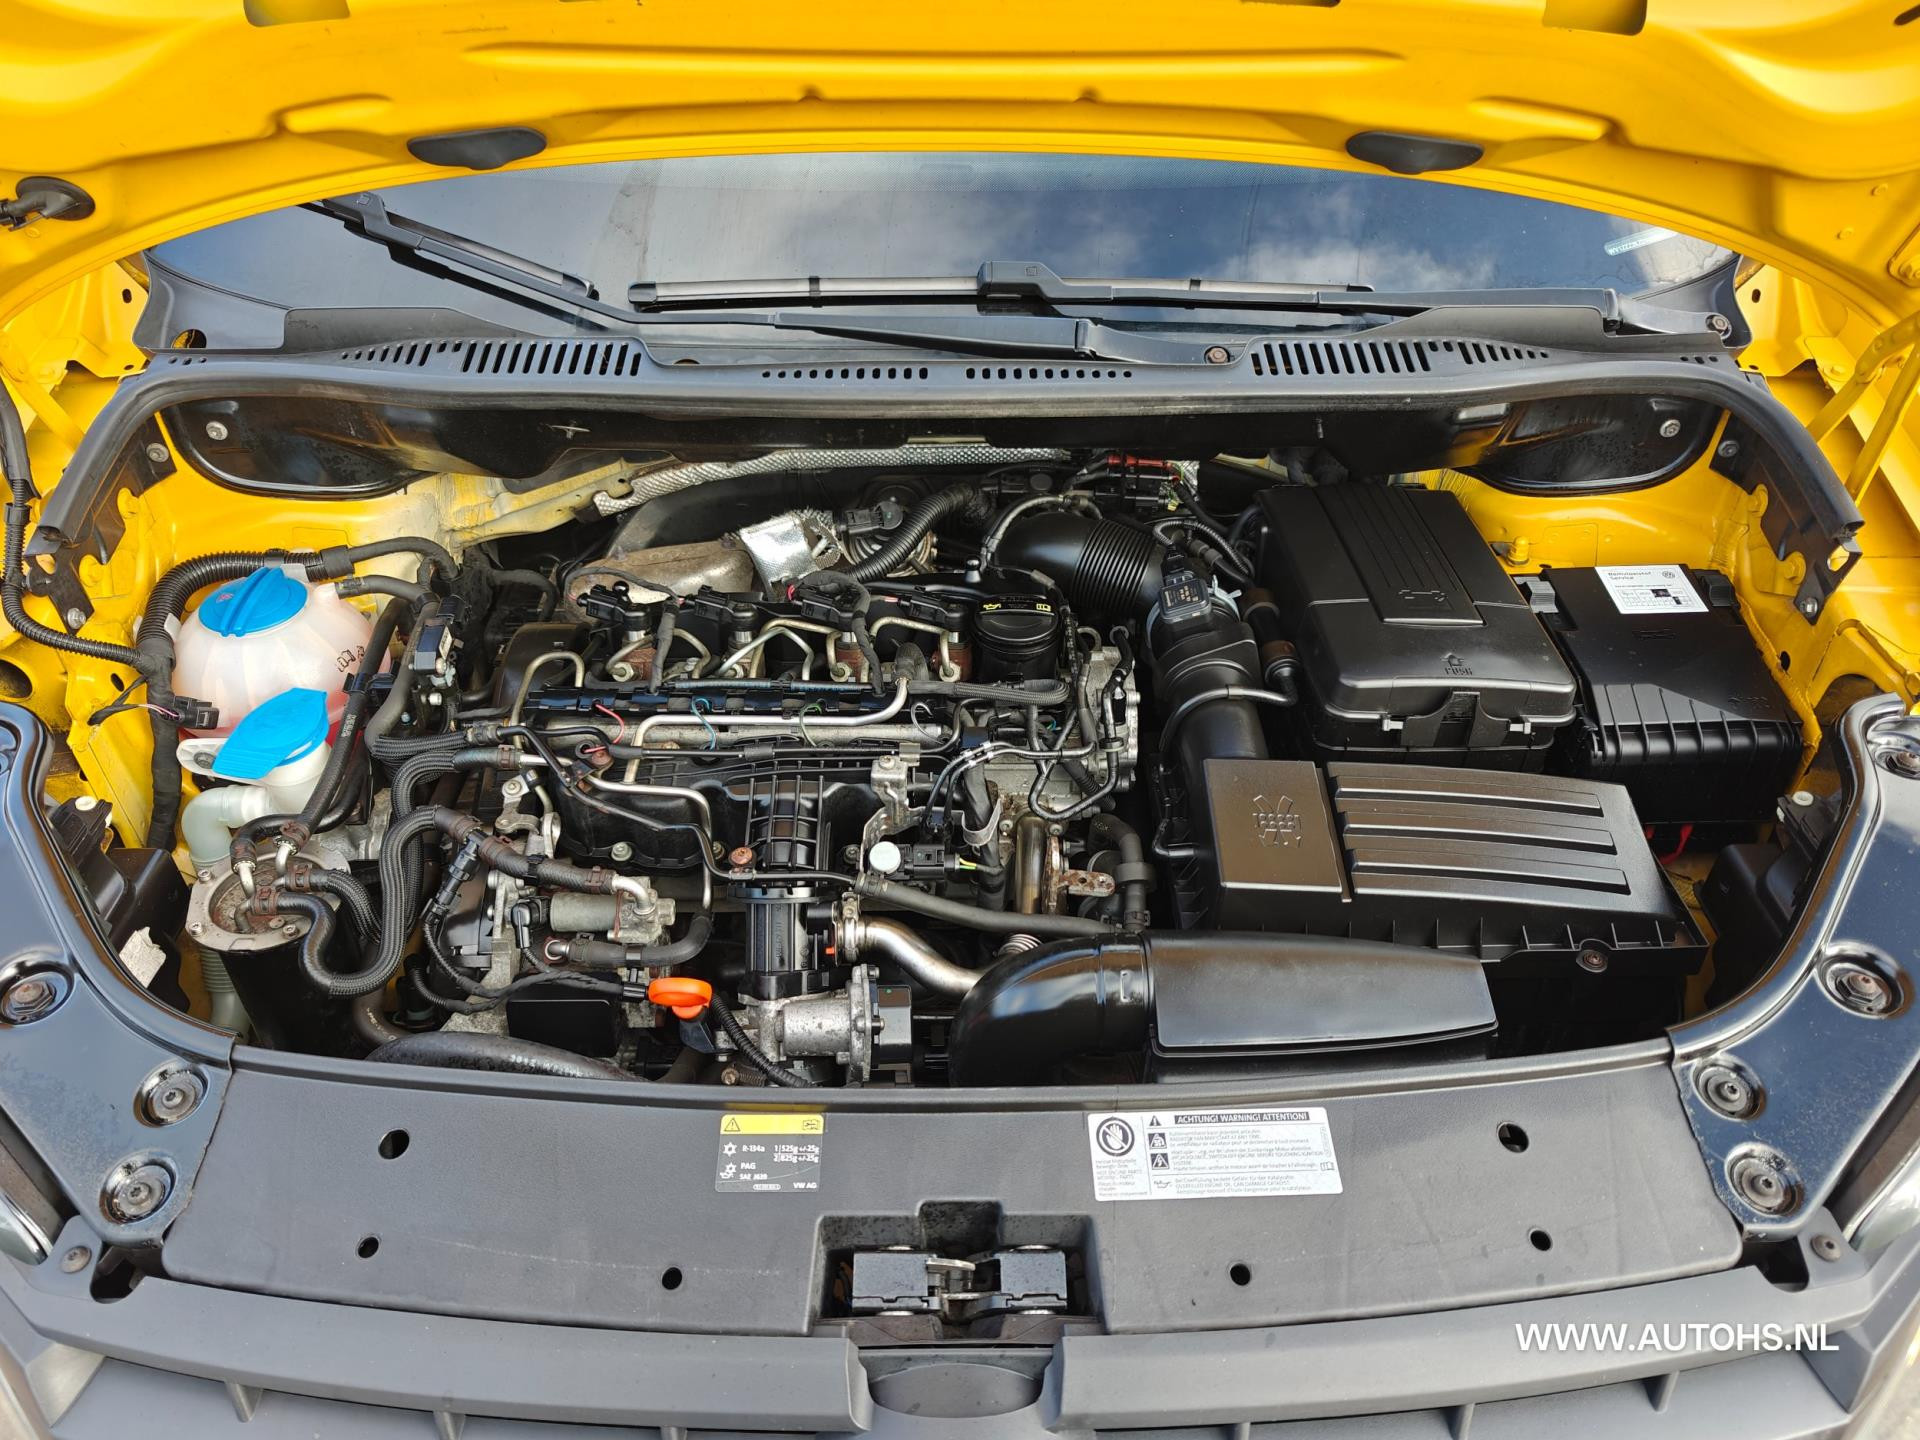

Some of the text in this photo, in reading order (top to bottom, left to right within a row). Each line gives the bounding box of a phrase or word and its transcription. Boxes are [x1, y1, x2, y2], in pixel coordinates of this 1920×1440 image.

[1444, 667, 1473, 676] PUSH
[1177, 1112, 1308, 1124] ACHTUNG! WARNING! ATTENTION!
[742, 1144, 766, 1152] R-134a
[740, 1162, 756, 1170] PAG
